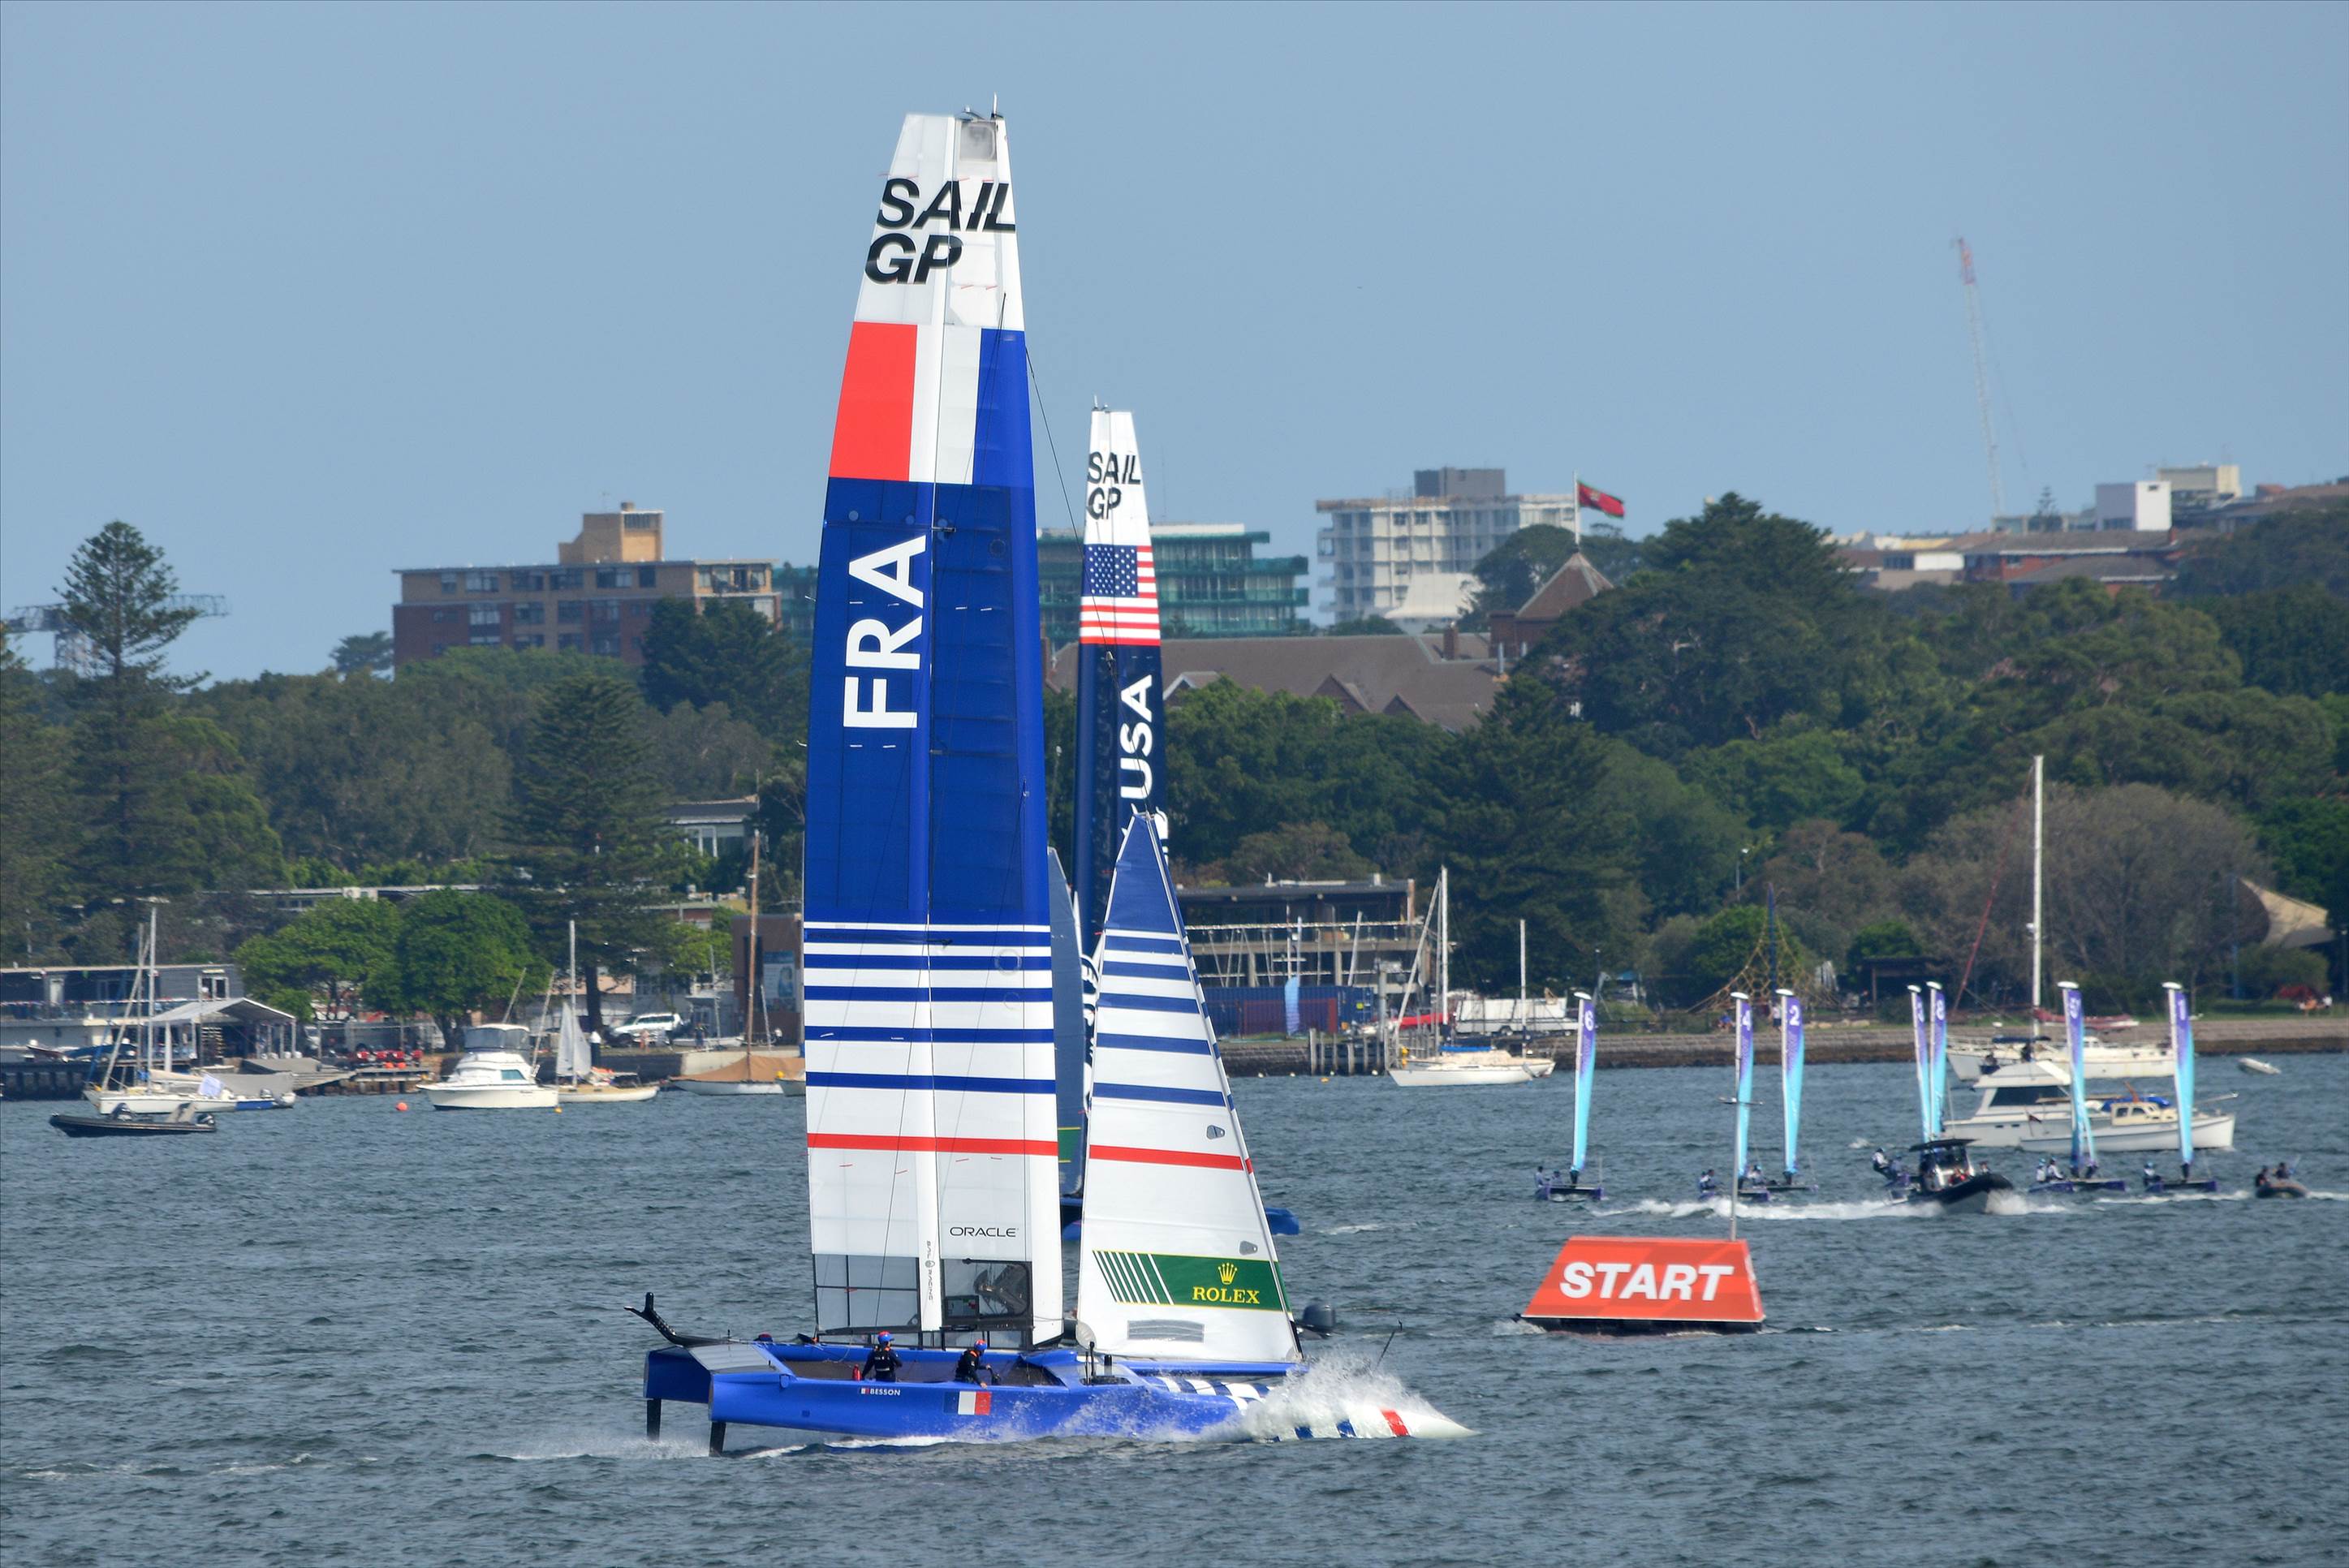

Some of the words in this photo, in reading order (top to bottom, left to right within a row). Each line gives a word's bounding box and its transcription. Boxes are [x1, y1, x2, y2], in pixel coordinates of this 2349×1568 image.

[877, 178, 1016, 232] SAIL
[864, 232, 963, 284] GP
[1088, 451, 1141, 485] SAIL
[1086, 487, 1122, 520] GP
[843, 535, 926, 728] FRA
[1119, 674, 1153, 799] USA
[1584, 1010, 1594, 1032] 6
[1742, 1010, 1752, 1032] 4
[1789, 1005, 1799, 1026] 2
[950, 1226, 1016, 1238] ORACLE
[1192, 1286, 1261, 1304] ROLEX
[1559, 1262, 1735, 1301] START
[870, 1388, 901, 1396] BESSON
